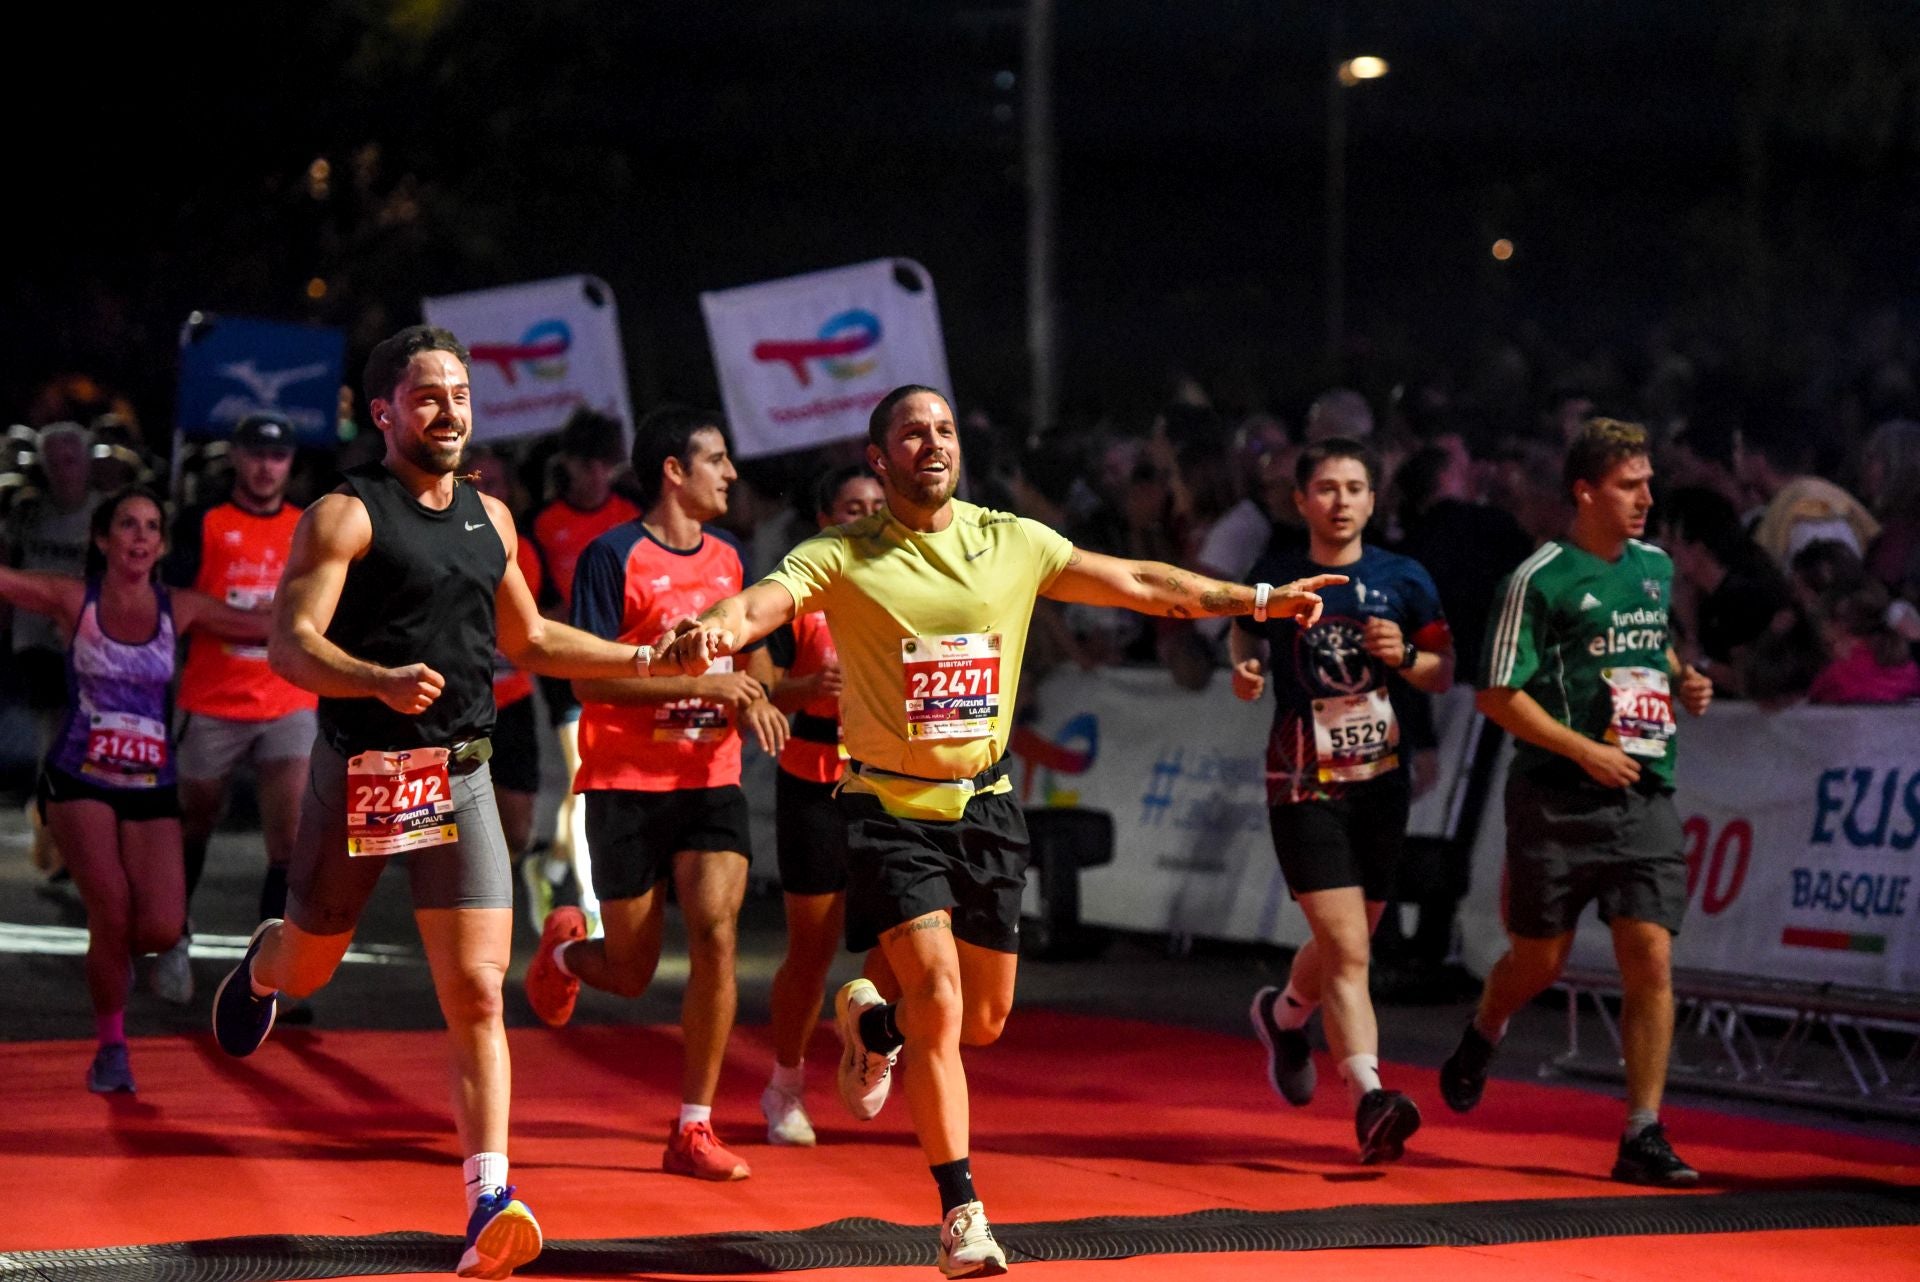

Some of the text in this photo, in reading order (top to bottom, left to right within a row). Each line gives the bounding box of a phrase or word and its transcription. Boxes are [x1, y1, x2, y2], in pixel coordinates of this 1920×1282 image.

[912, 668, 993, 698] 22471
[1329, 720, 1387, 748] 5529
[355, 775, 443, 812] 22472
[1790, 866, 1911, 918] BASQUE
